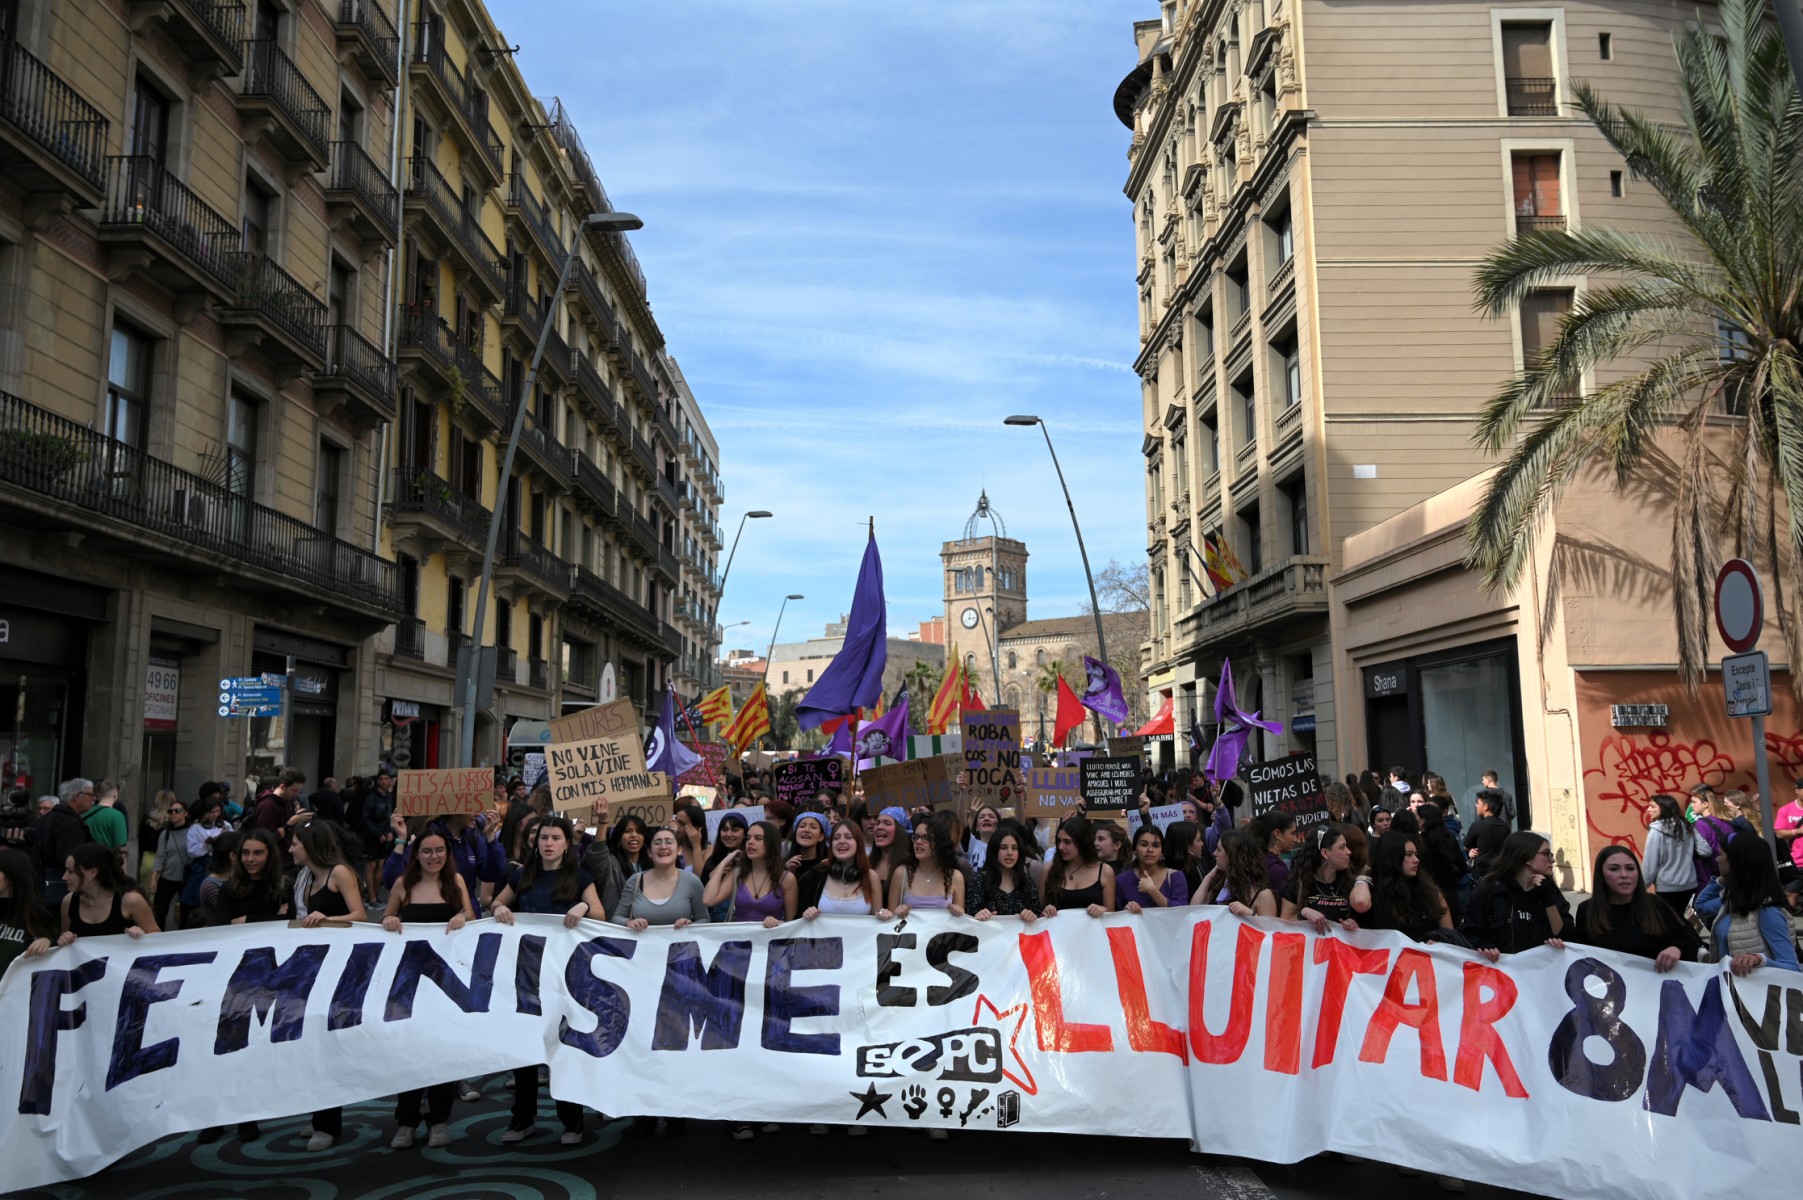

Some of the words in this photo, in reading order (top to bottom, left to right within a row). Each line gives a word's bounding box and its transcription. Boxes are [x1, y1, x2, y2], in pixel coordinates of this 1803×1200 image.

[1731, 663, 1756, 676] Excepte
[1374, 675, 1397, 692] Shana
[1735, 679, 1751, 691] Taxis
[968, 723, 1013, 742] ROBA,
[551, 748, 573, 768] NO
[576, 742, 620, 761] VINE
[965, 749, 987, 762] COS
[997, 750, 1020, 769] NO
[965, 767, 1016, 786] TOCA
[1086, 763, 1105, 771] LLUITO
[1250, 762, 1294, 783] SOMOS
[1295, 758, 1314, 774] LAS
[403, 772, 438, 794] IT'S
[441, 772, 455, 792] A
[458, 770, 493, 792] DRESS
[556, 785, 579, 801] CON
[582, 780, 606, 797] MIS
[610, 772, 661, 792] HERMANAS
[1039, 794, 1056, 807] NO
[1254, 784, 1297, 805] NIETAS
[1302, 779, 1317, 794] DE
[402, 794, 434, 815] NOT
[435, 795, 450, 813] A
[454, 792, 484, 813] YES
[1160, 809, 1178, 819] MÁS
[18, 931, 844, 1116] FEMINISME
[876, 919, 979, 1007] ÉS
[1018, 920, 1530, 1099] LLUITAR
[1548, 956, 1773, 1123] 8M
